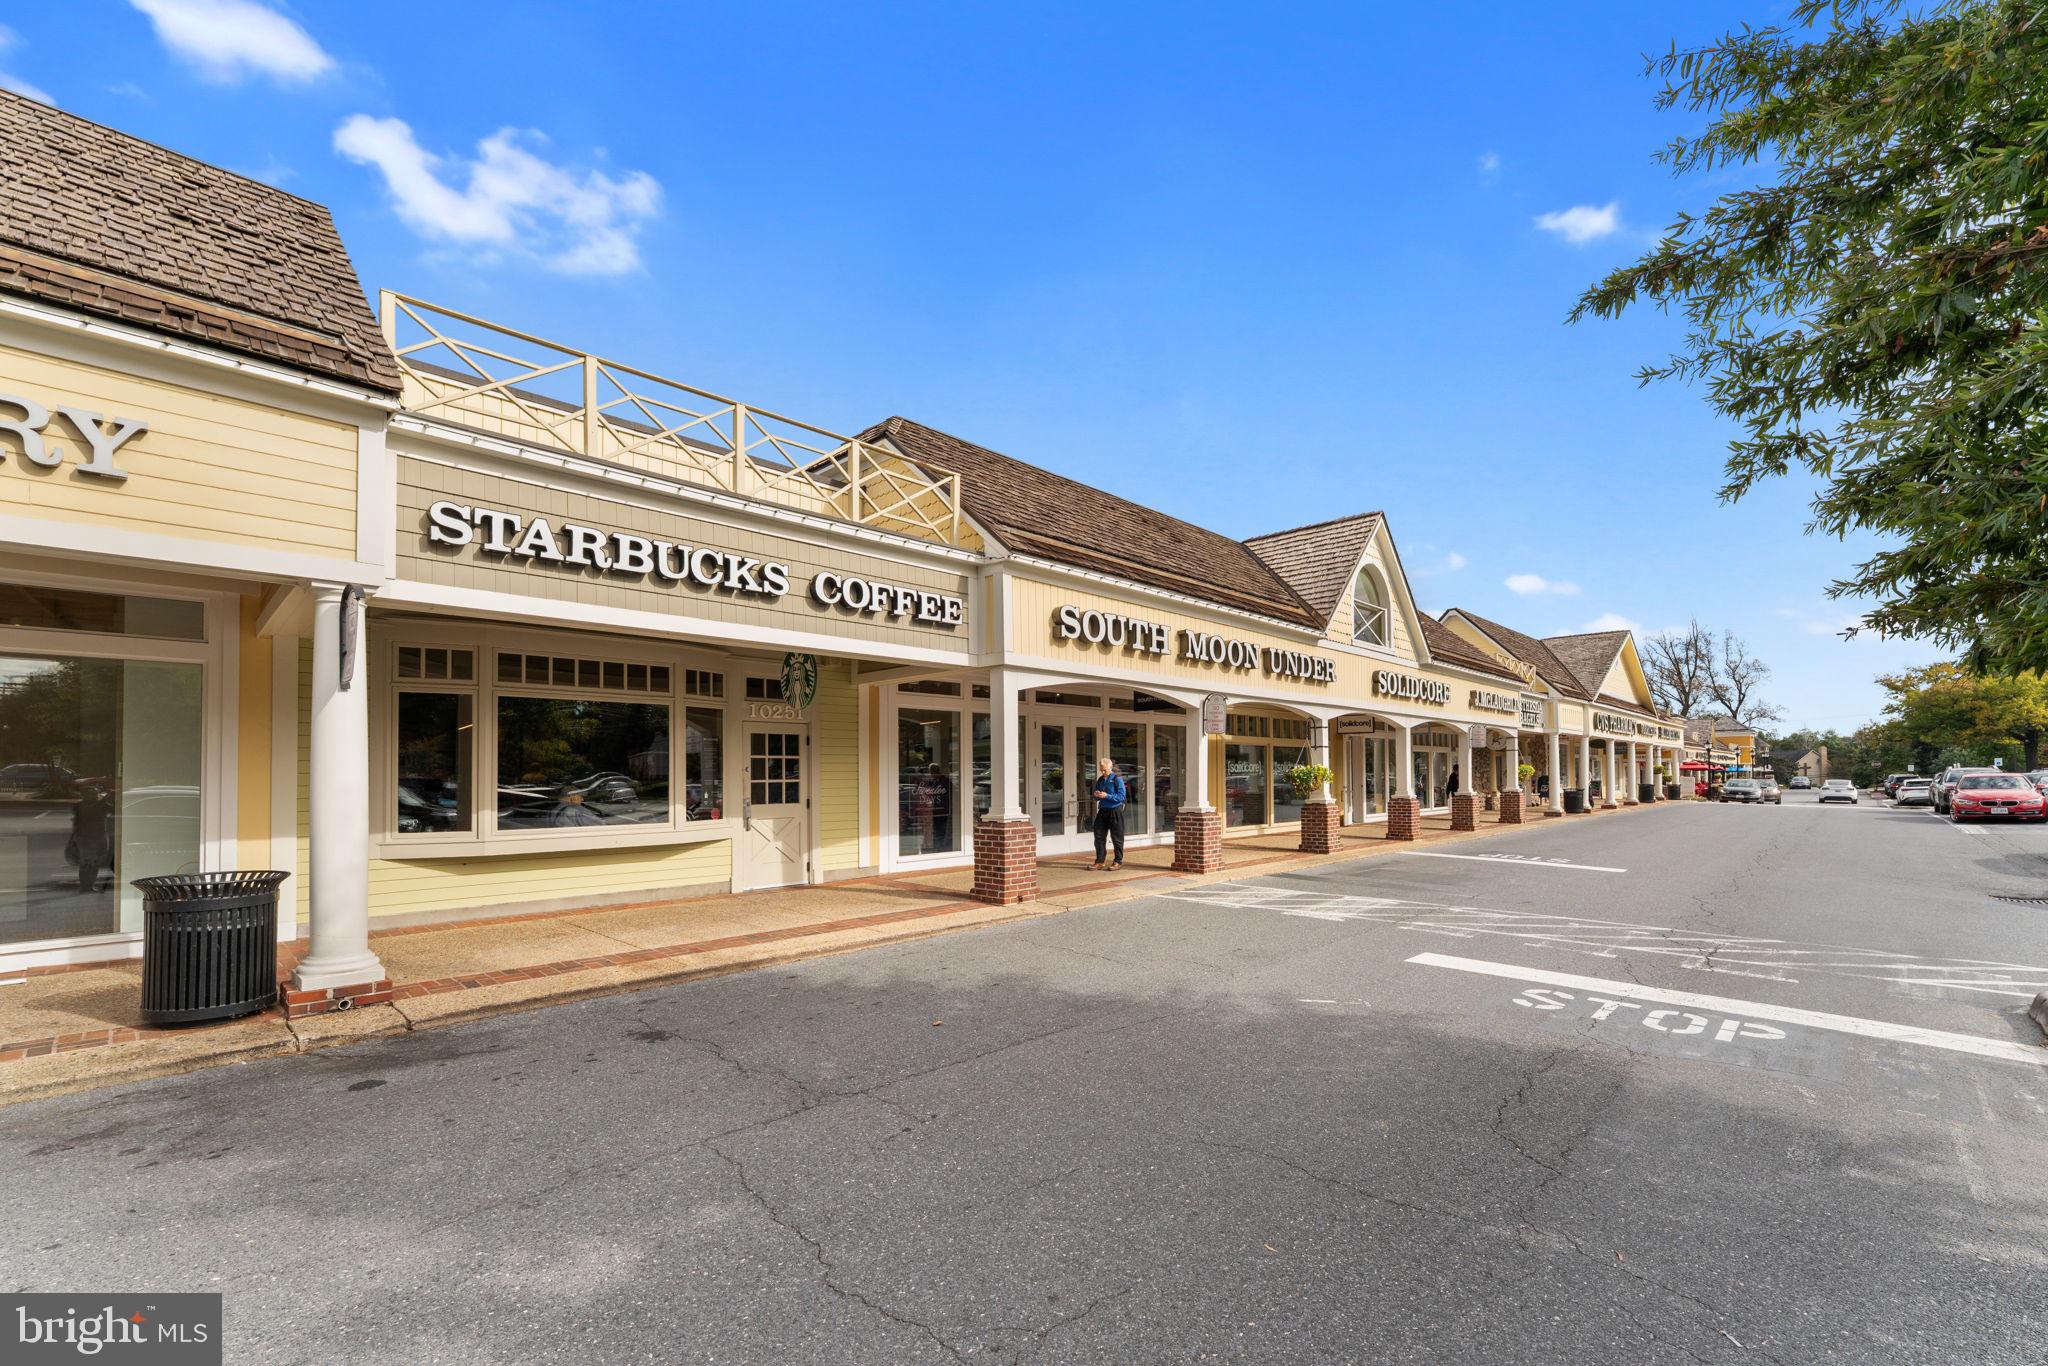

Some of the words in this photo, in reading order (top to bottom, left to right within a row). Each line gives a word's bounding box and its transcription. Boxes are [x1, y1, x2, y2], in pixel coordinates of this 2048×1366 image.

[428, 500, 790, 597] STARBUCKS
[810, 570, 963, 626] COFFEE
[1054, 604, 1171, 656] SOUTH
[1179, 628, 1260, 670] MOON
[1264, 646, 1338, 683] UNDER
[749, 703, 803, 720] 10251
[1374, 669, 1451, 704] SOLIDCORE
[1511, 988, 1787, 1042] STOP
